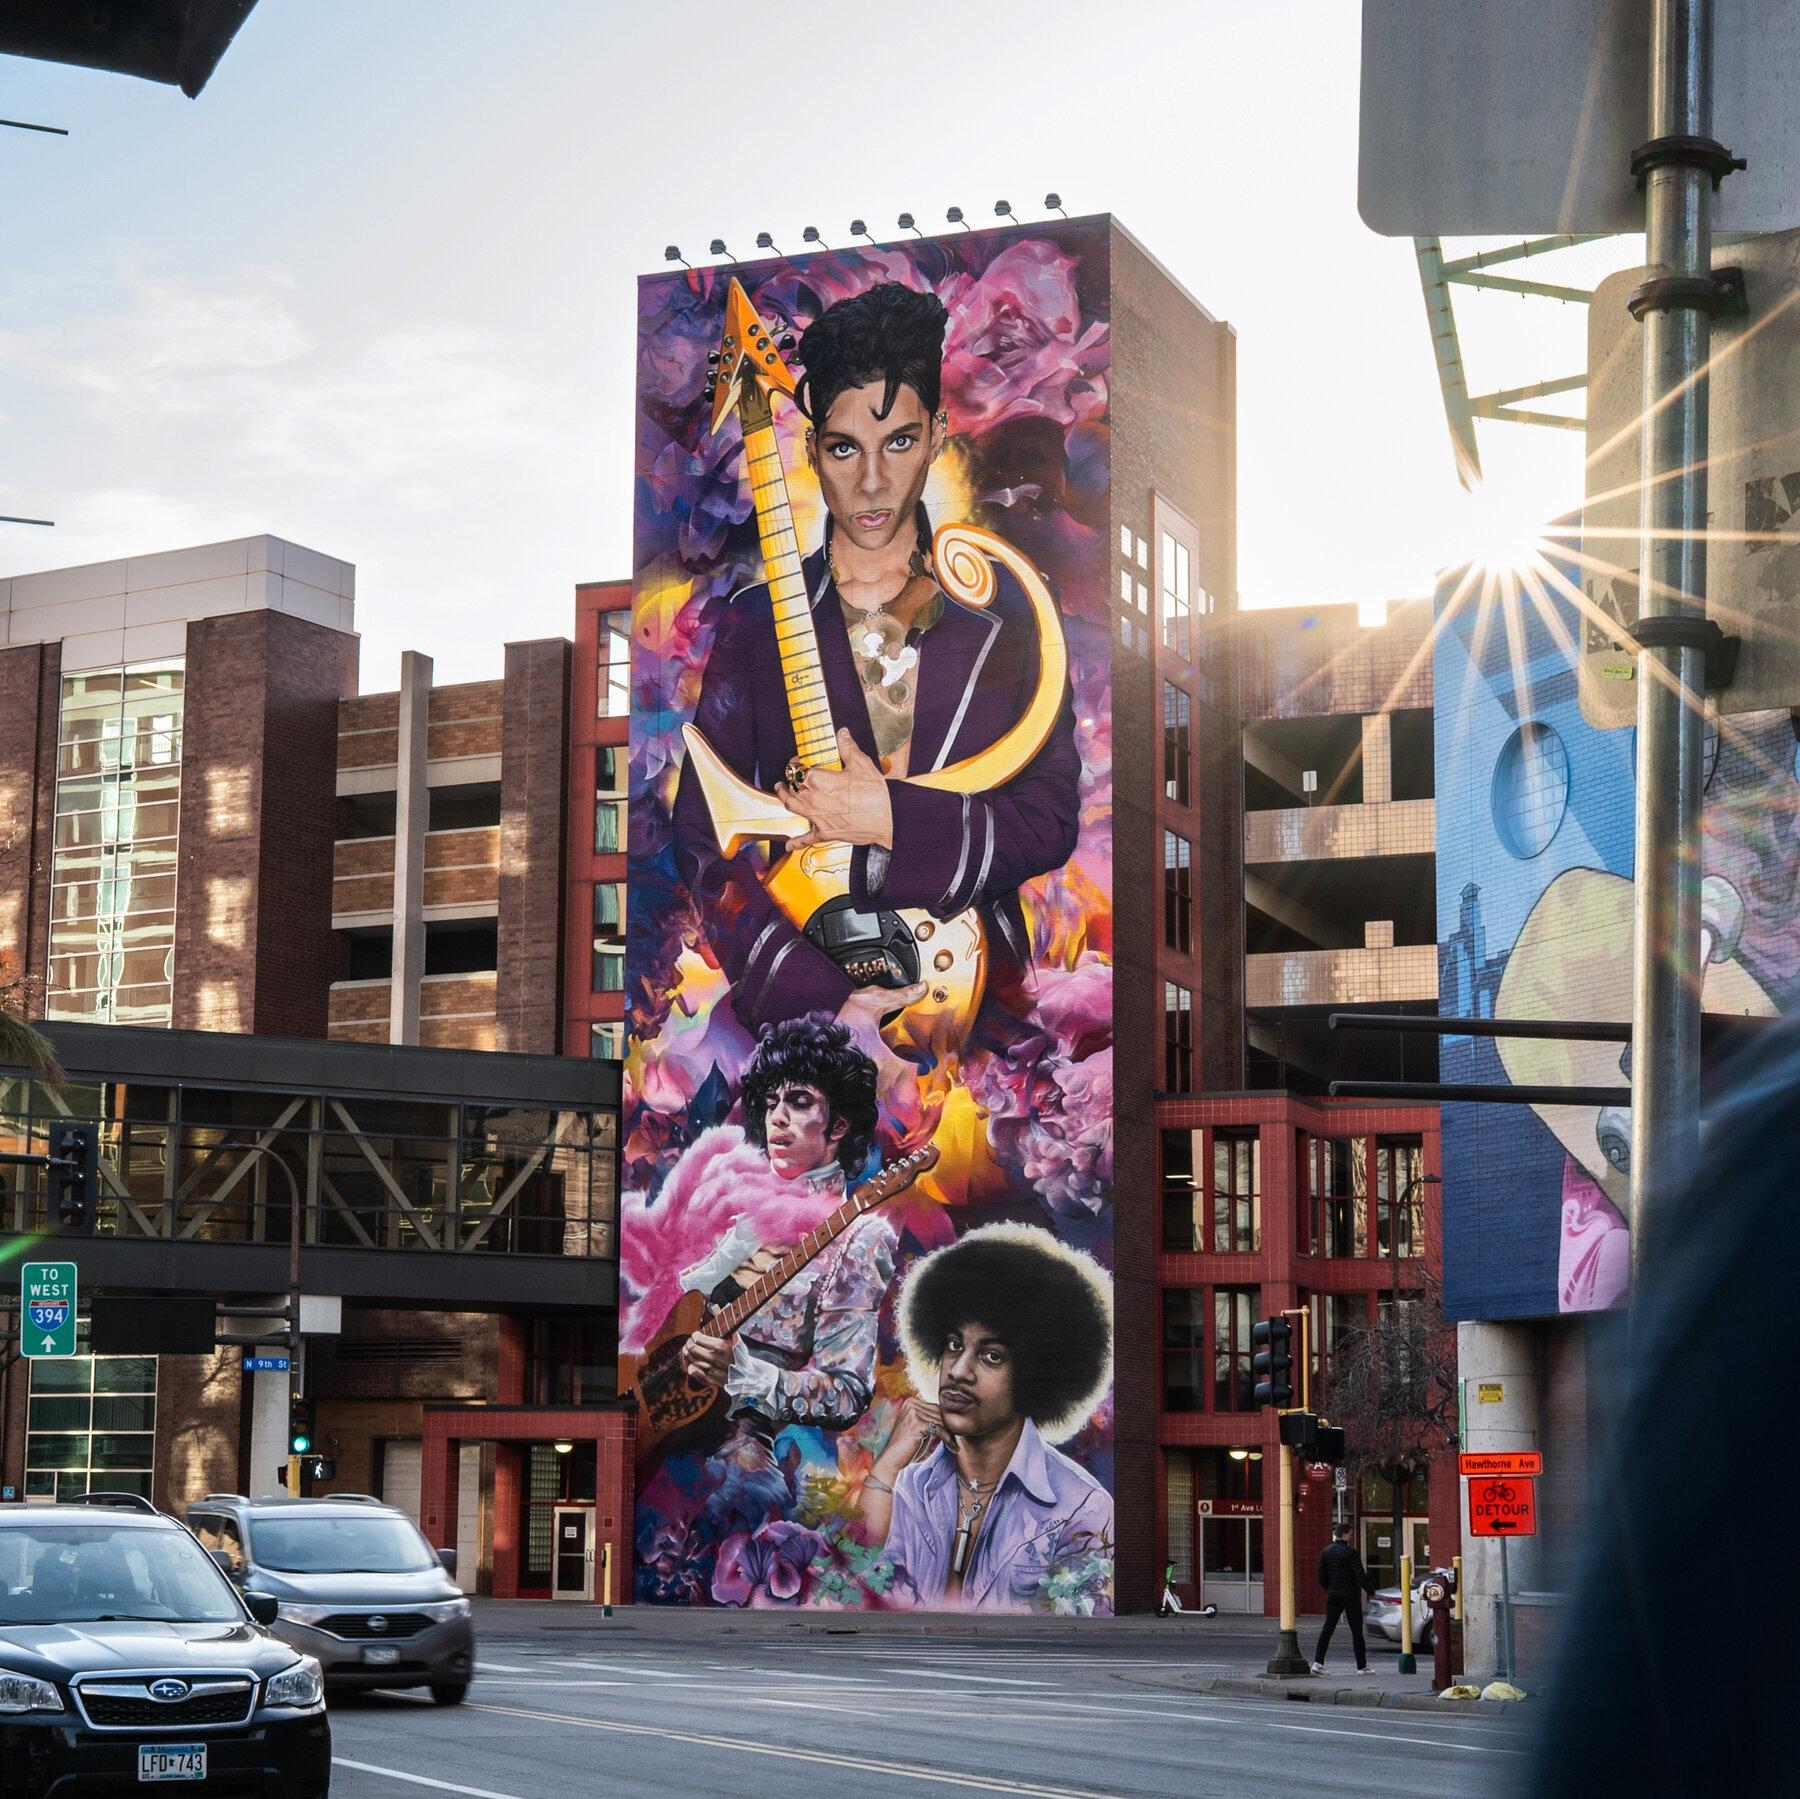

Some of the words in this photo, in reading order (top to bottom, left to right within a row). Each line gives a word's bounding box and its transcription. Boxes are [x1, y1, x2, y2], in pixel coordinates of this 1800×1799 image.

[40, 1268, 59, 1281] TO
[30, 1284, 69, 1296] WEST
[35, 1309, 63, 1323] 394
[246, 1360, 252, 1368] N
[258, 1360, 273, 1368] 9th
[278, 1360, 287, 1368] St
[1465, 1459, 1512, 1469] Hawthorne
[1519, 1458, 1535, 1468] Ave
[1240, 1504, 1254, 1512] Ave
[1476, 1504, 1529, 1516] DETOUR
